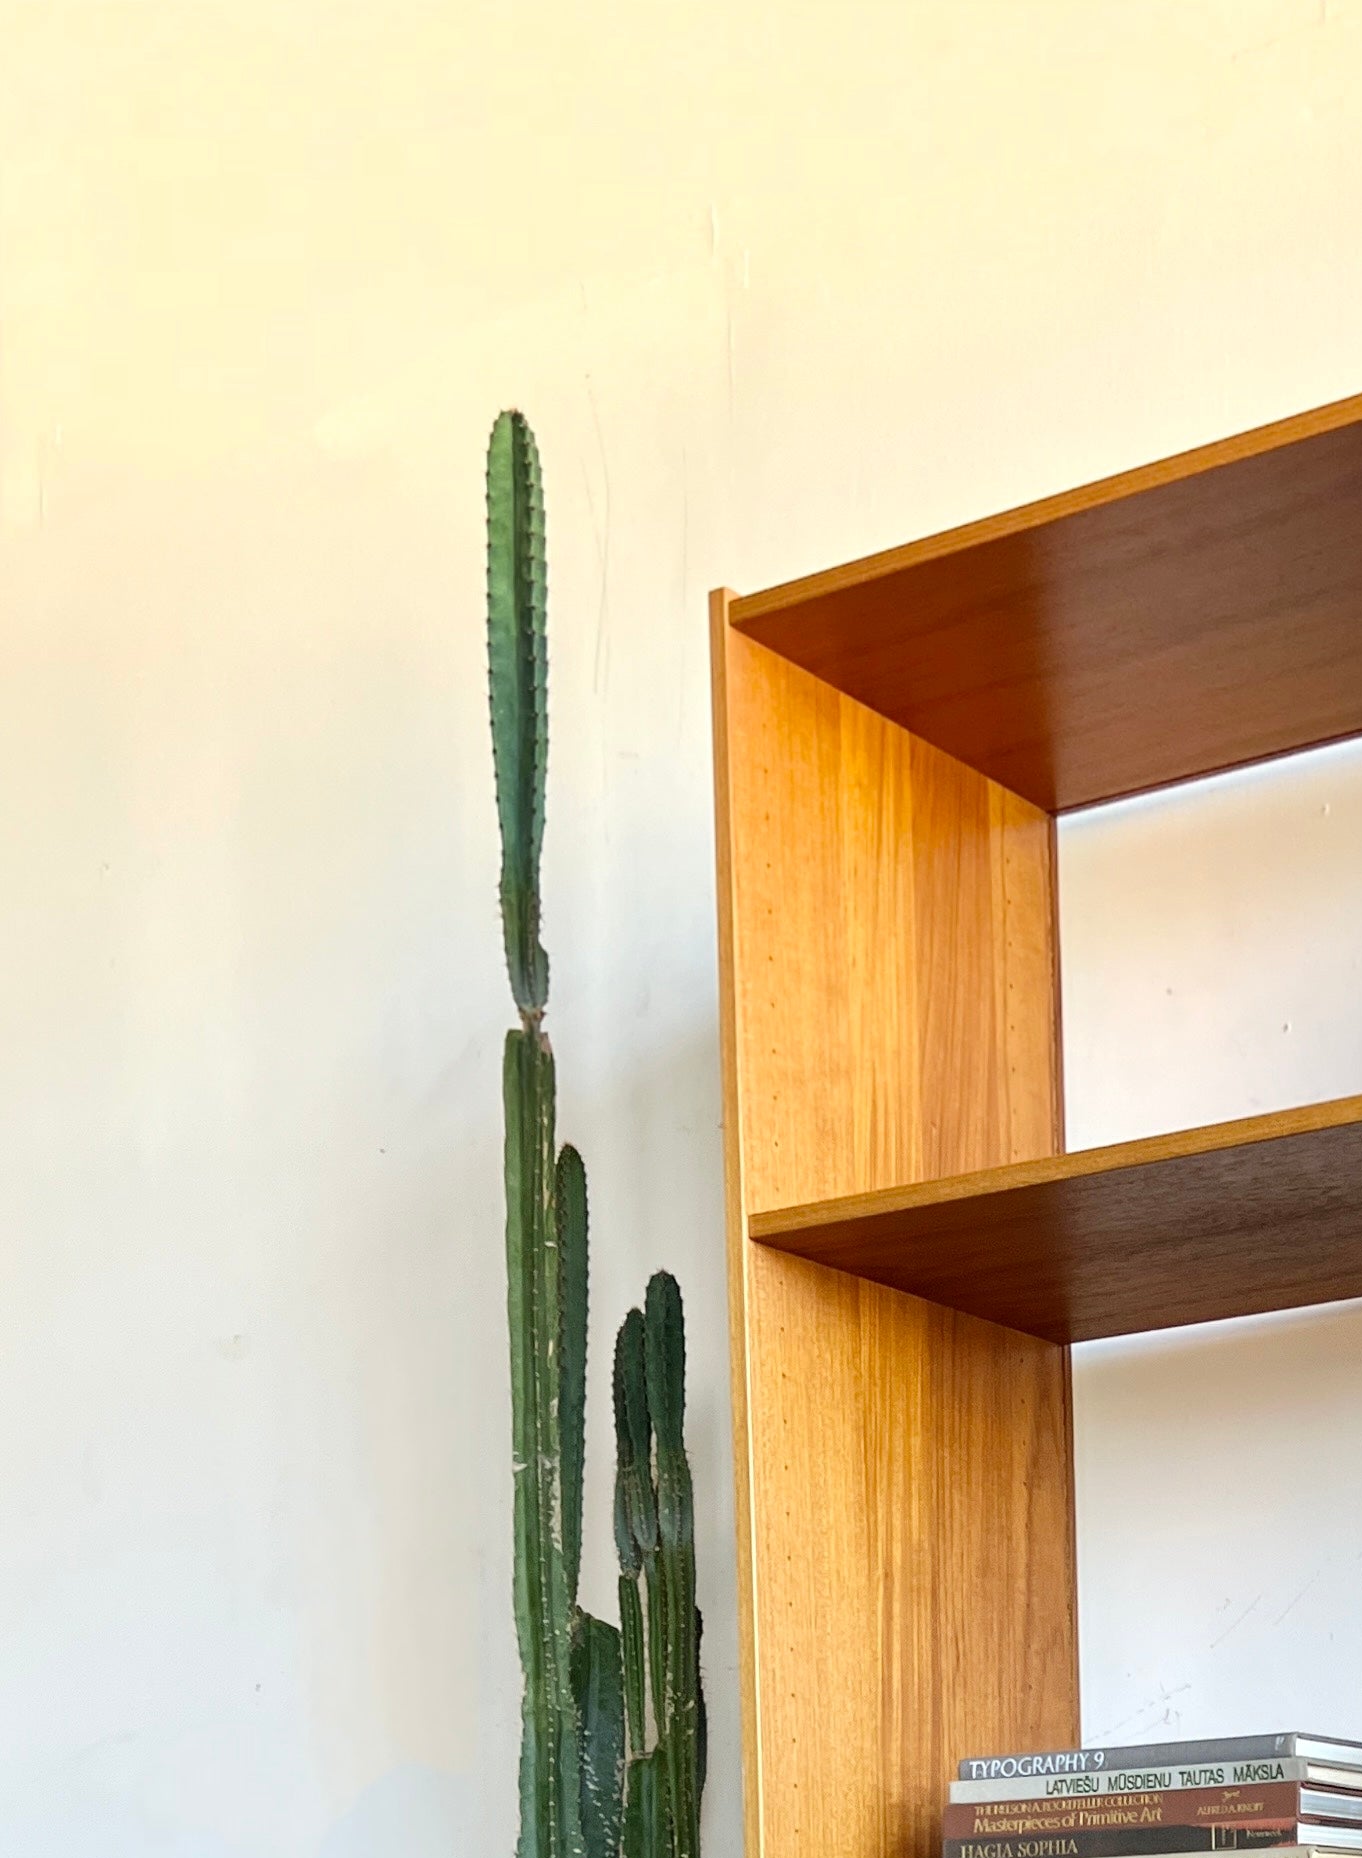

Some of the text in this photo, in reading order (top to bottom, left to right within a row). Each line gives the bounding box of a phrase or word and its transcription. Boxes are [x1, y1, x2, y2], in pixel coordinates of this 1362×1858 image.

[969, 1751, 1105, 1779] TYPOGRAPHY 9
[1046, 1763, 1285, 1796] LATVIEŠU MŪSDIENU TAUTAS MĀKSLA
[973, 1807, 1162, 1834] Masterpieces of Primitive Art
[1017, 1838, 1078, 1858] SOPHIA
